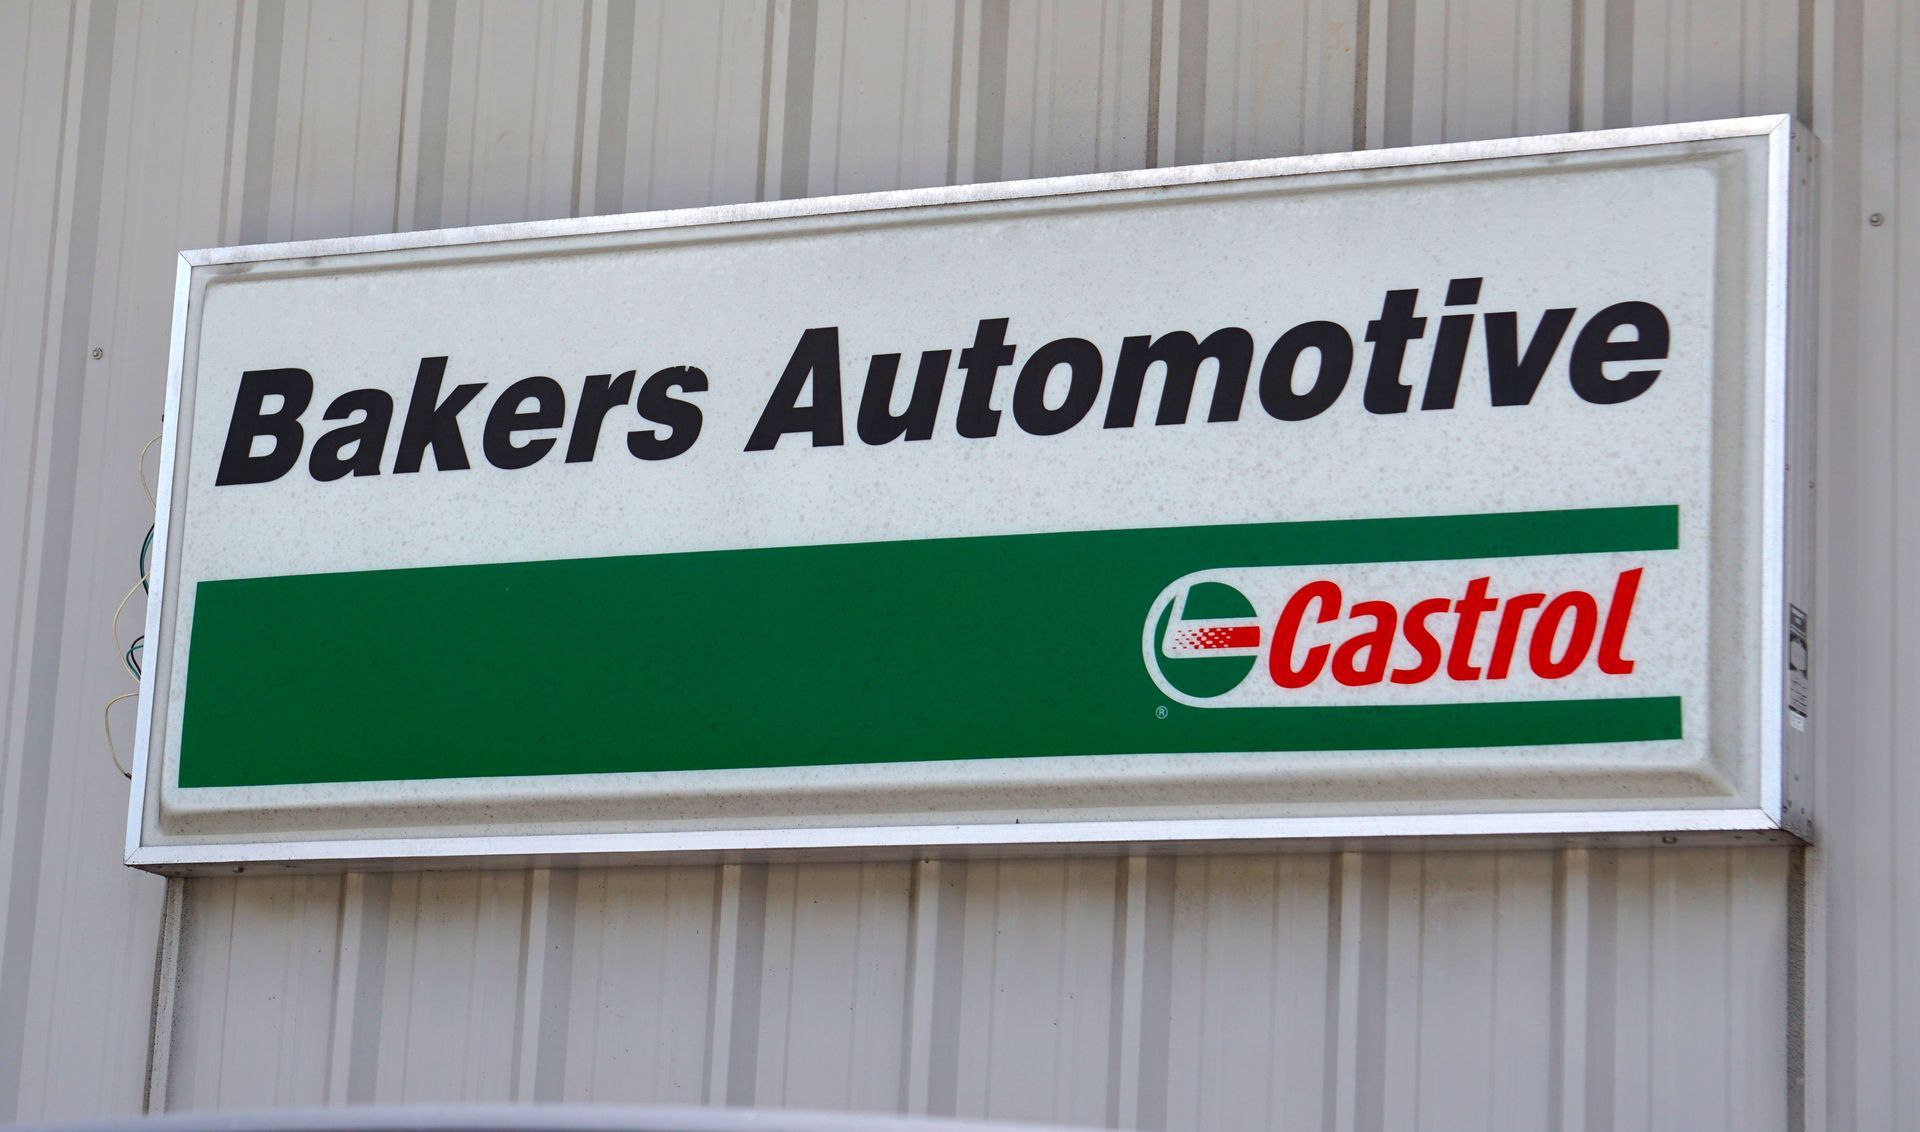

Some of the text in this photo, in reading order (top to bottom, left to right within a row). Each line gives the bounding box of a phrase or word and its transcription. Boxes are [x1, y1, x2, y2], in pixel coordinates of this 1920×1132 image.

[215, 277, 1670, 487] Bakers Automotive
[1268, 567, 1643, 689] Castrol
